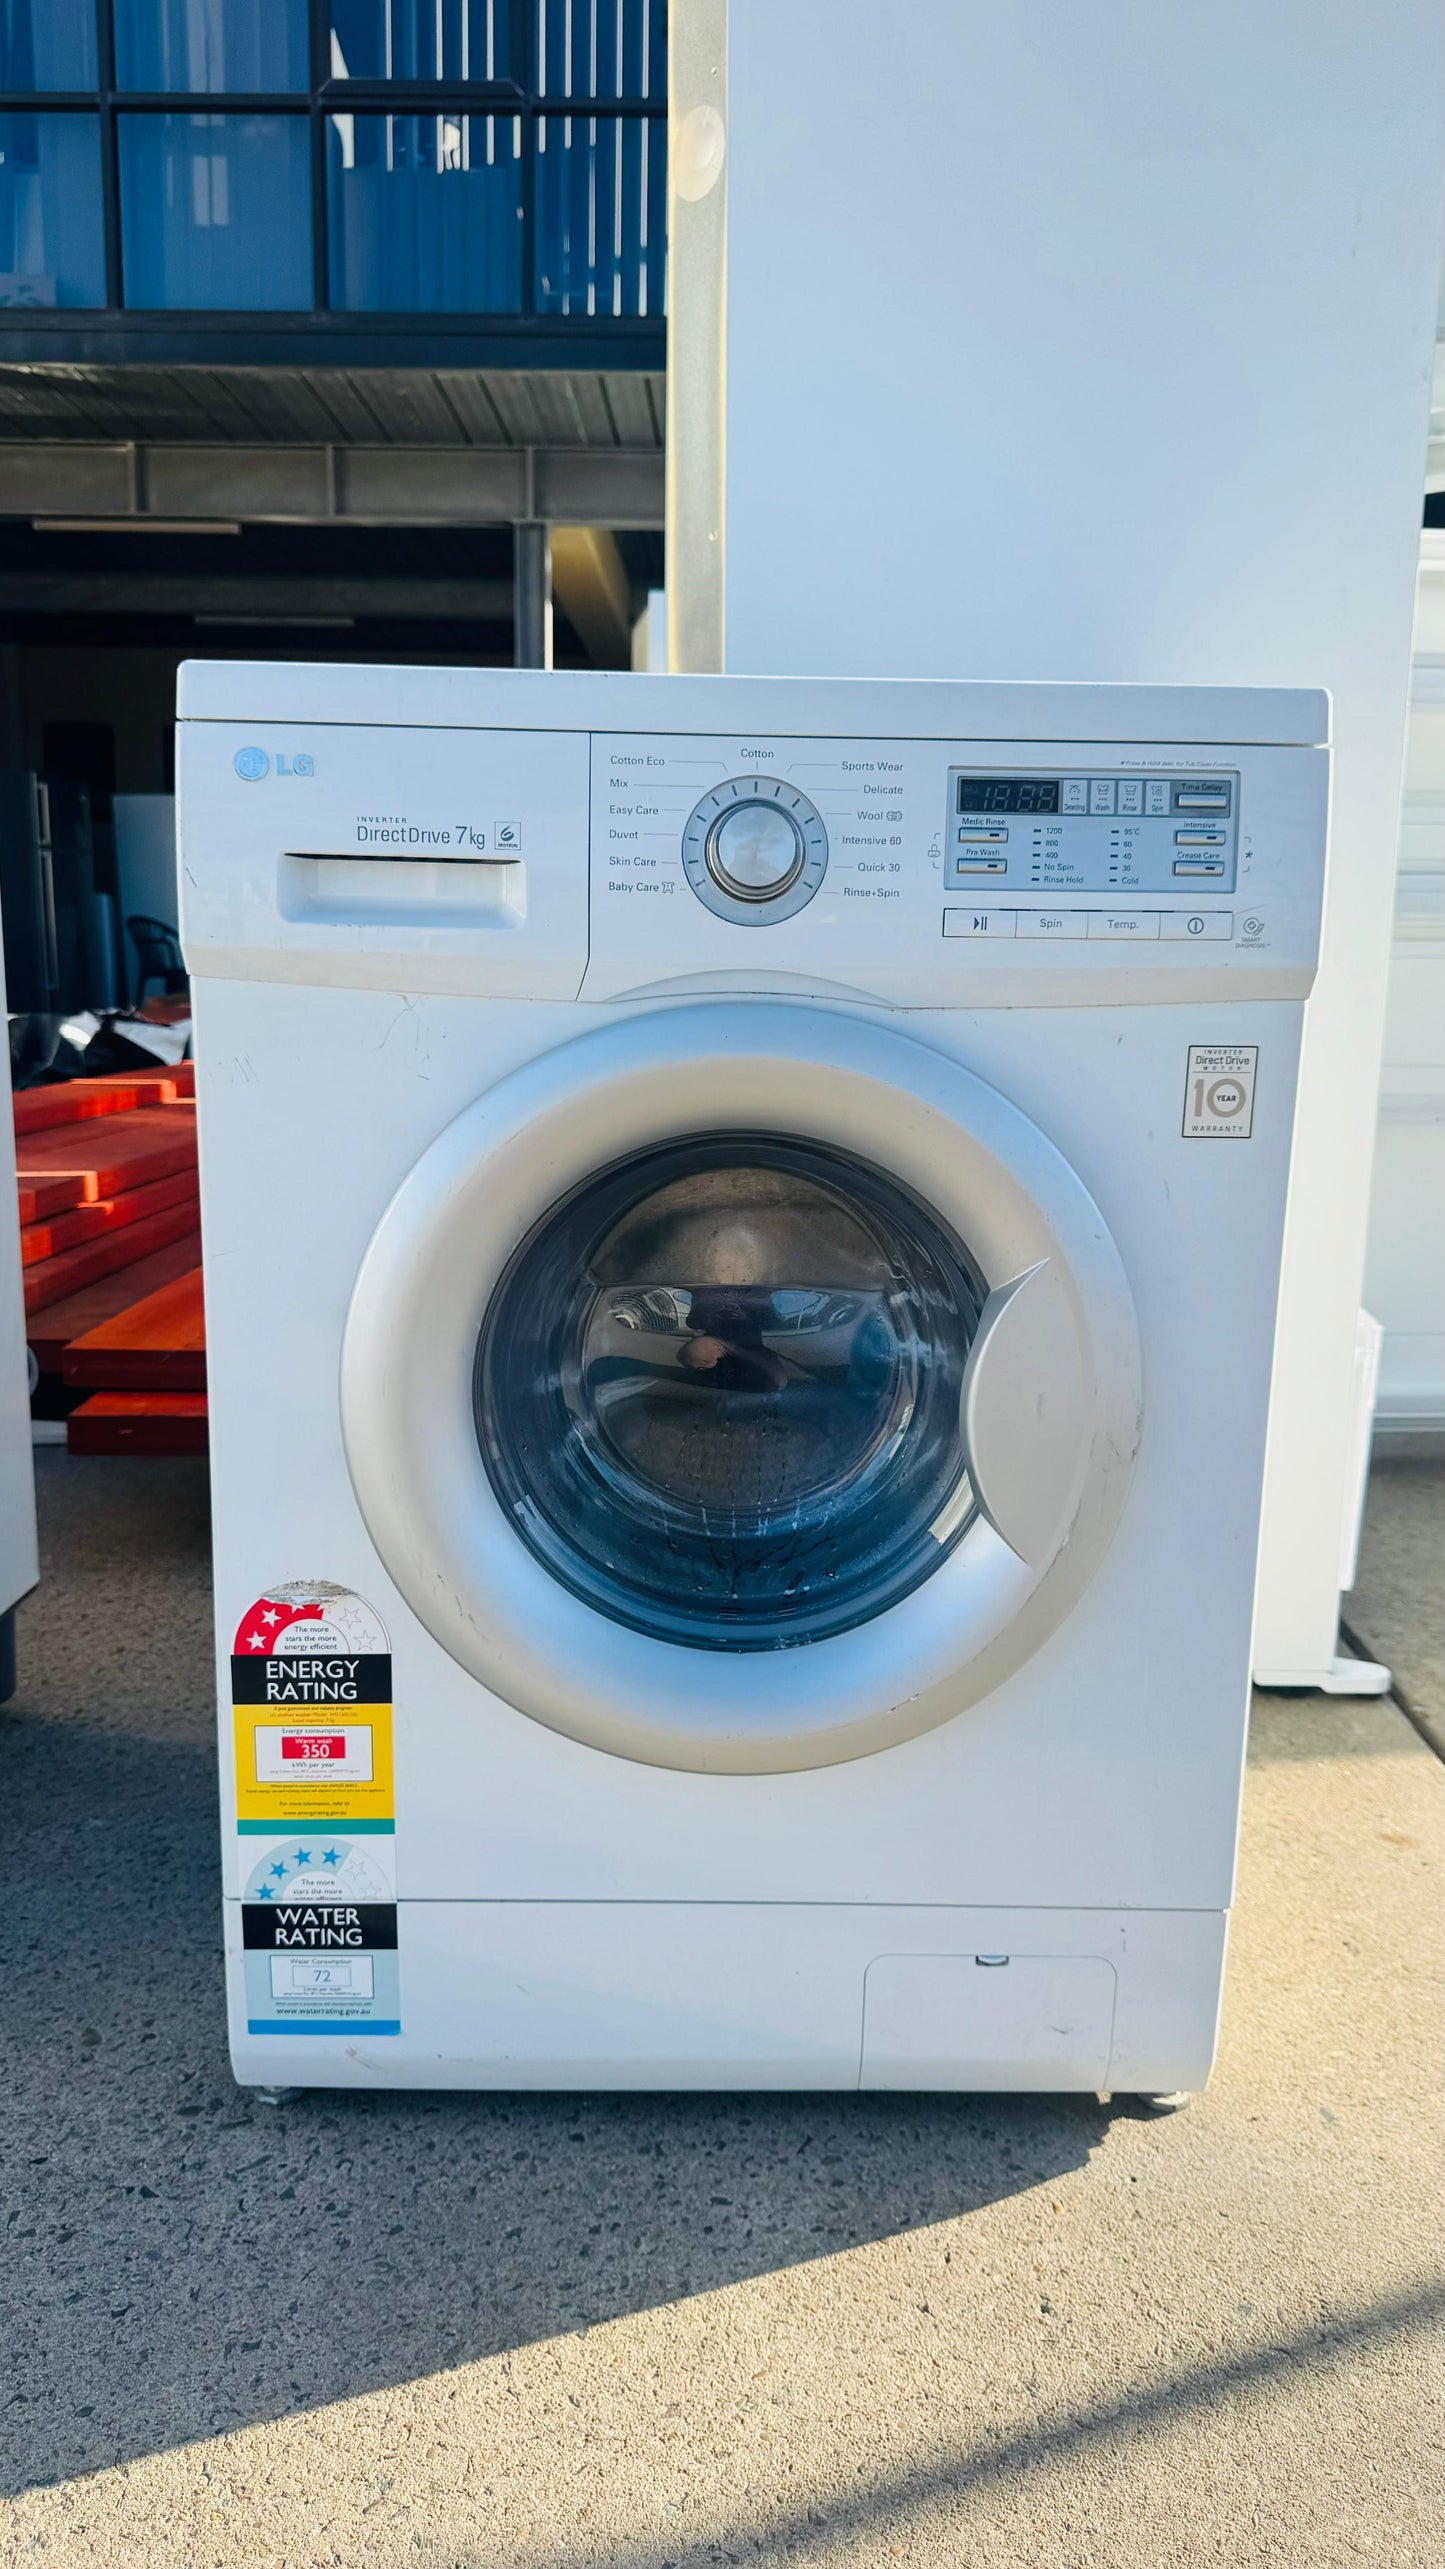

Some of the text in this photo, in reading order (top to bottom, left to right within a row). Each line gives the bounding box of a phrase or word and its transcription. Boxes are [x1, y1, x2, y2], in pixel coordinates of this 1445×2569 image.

[740, 749, 774, 758] Cotton
[276, 754, 313, 776] LG
[610, 755, 665, 766] Cotton Eco
[841, 761, 904, 772] Sports Wear
[609, 778, 629, 788] Mix
[863, 784, 903, 794] Delicate
[1182, 784, 1223, 793] Time Delay
[609, 804, 659, 816] Easy Care
[1096, 803, 1110, 811] Wash
[1123, 804, 1137, 812] Rinse
[1151, 804, 1163, 813] Spin
[356, 816, 408, 824] INVERTER
[857, 811, 884, 820] Wool
[962, 818, 1006, 827] Medic Rinse
[1183, 821, 1217, 829] Intensive
[609, 829, 639, 840] Duvet
[1046, 827, 1063, 836] 1200
[842, 835, 902, 846] Intensive 60
[1045, 839, 1059, 848] 800
[1123, 840, 1133, 849] 60
[966, 849, 1000, 858] Pre Wash
[1044, 851, 1059, 860] 400
[1122, 852, 1132, 861] 40
[1176, 851, 1221, 860] Crease Care
[609, 856, 657, 867] Skin Care
[857, 862, 901, 873] Quick 30
[1044, 863, 1074, 873] No Spin
[1122, 864, 1131, 873] 30
[1043, 875, 1084, 884] Rinse Hold
[1121, 877, 1139, 886] Cold
[608, 881, 659, 893] Baby Care
[843, 887, 901, 899] Rinse+Spin
[1039, 918, 1063, 929] Spin
[1107, 919, 1140, 931] Temp.
[1195, 1055, 1250, 1065] Direct Drive
[1194, 1078, 1247, 1118] 10
[294, 1625, 308, 1633] The
[304, 1634, 316, 1642] the
[266, 1660, 360, 1679] ENERGY
[266, 1681, 358, 1701] RATING
[302, 1744, 330, 1759] 350
[275, 1908, 360, 1926] WATER
[275, 1928, 363, 1946] RATING
[313, 1969, 331, 1982] 72
[276, 2007, 371, 2016] www.waterrating.gov.au
